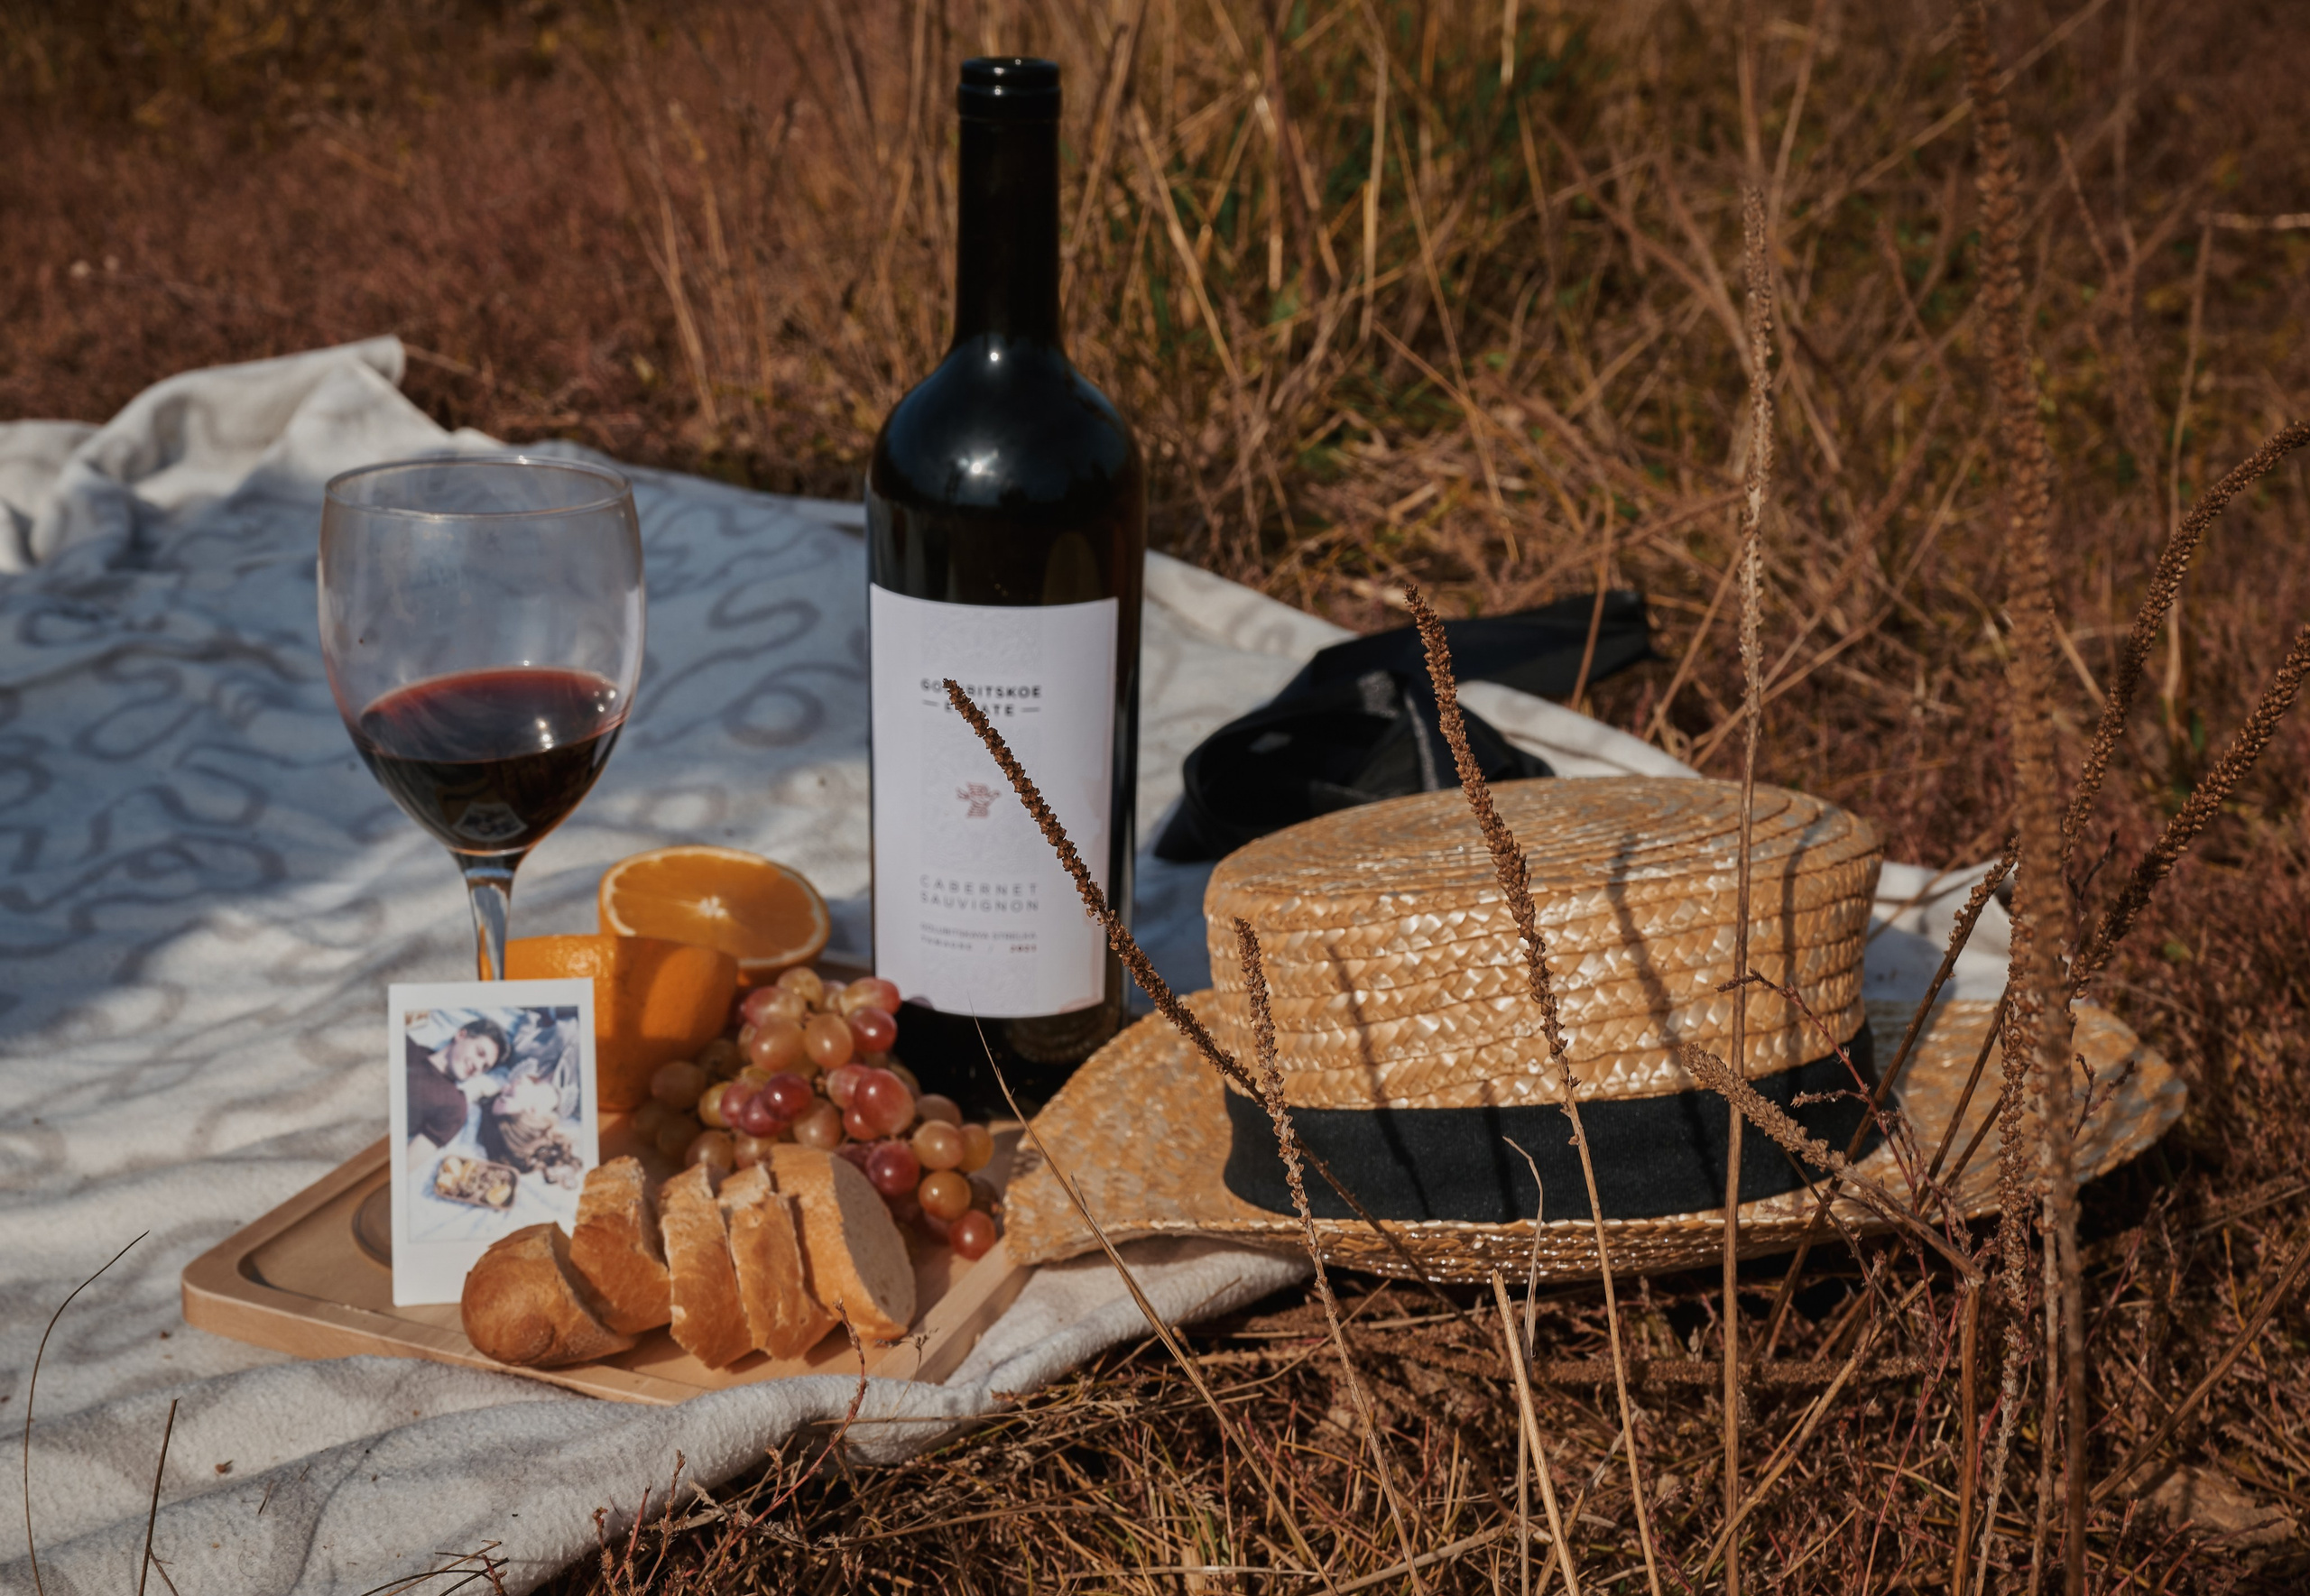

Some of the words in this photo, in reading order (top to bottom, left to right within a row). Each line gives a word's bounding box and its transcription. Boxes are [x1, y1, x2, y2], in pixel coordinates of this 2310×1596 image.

[920, 678, 1042, 698] GOBITSKOE
[944, 701, 1015, 717] EATE
[919, 874, 1039, 896] CABERNET
[919, 890, 1039, 913] SAUVIGNON
